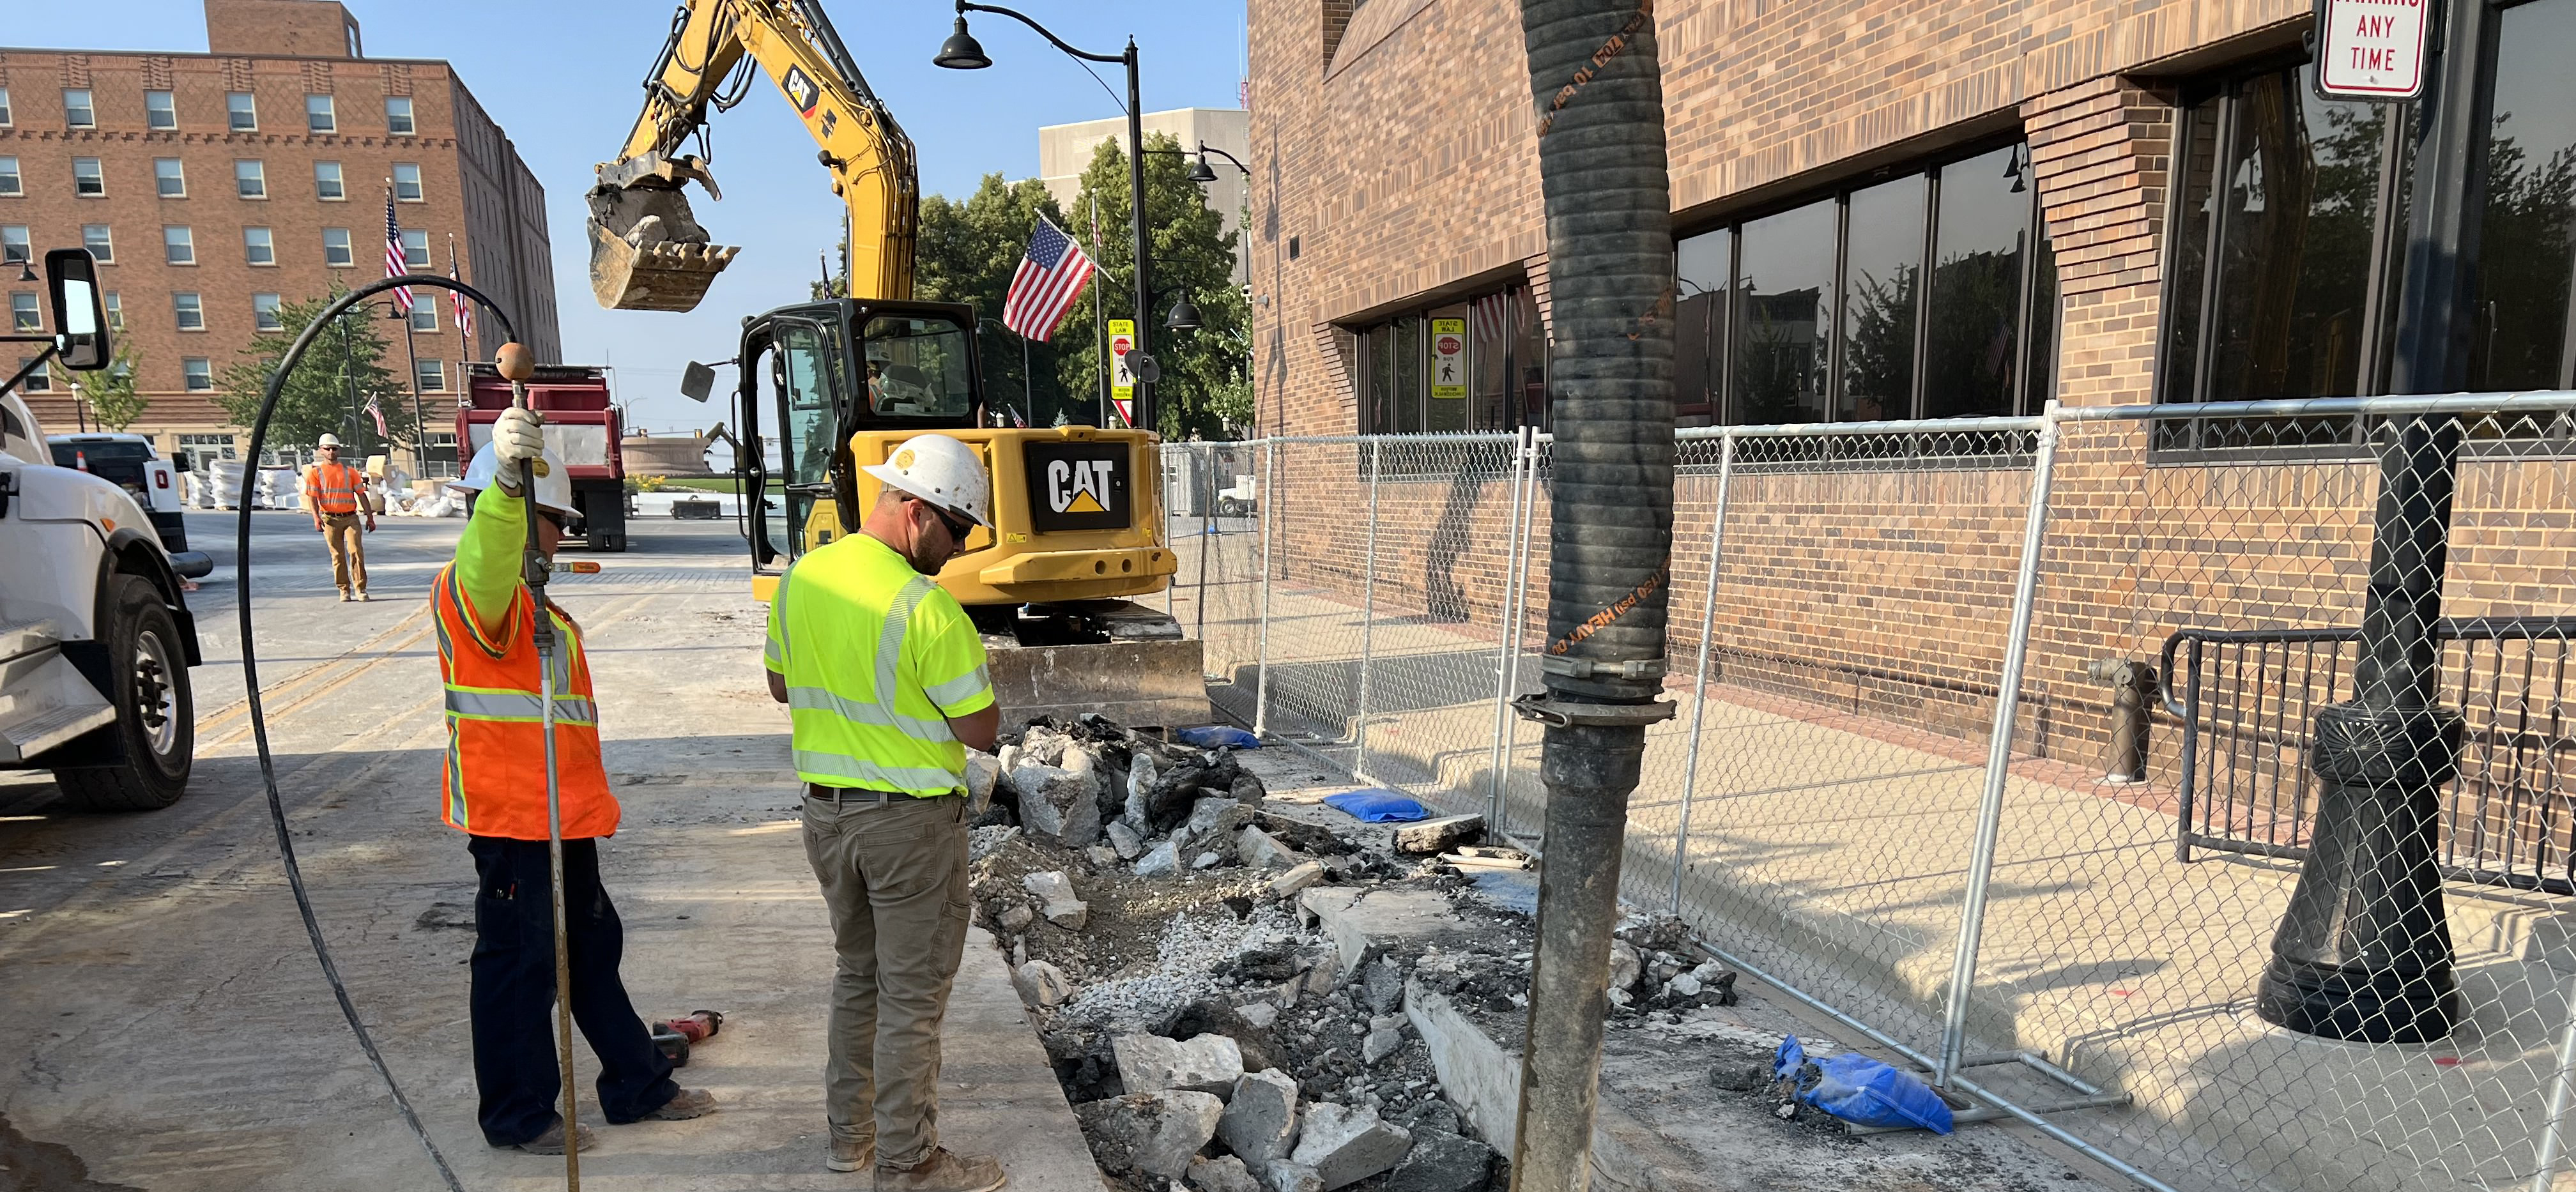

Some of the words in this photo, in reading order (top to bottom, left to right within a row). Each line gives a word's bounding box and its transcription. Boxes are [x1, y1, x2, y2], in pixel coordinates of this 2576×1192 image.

[2356, 15, 2395, 38] ANY
[1594, 38, 1621, 65] 704
[2351, 47, 2395, 71] TIME
[788, 68, 810, 108] CAT
[1574, 65, 1594, 86] 10
[1048, 459, 1113, 513] CAT
[1614, 592, 1636, 616] psi)
[1570, 607, 1616, 646] HEAVY
